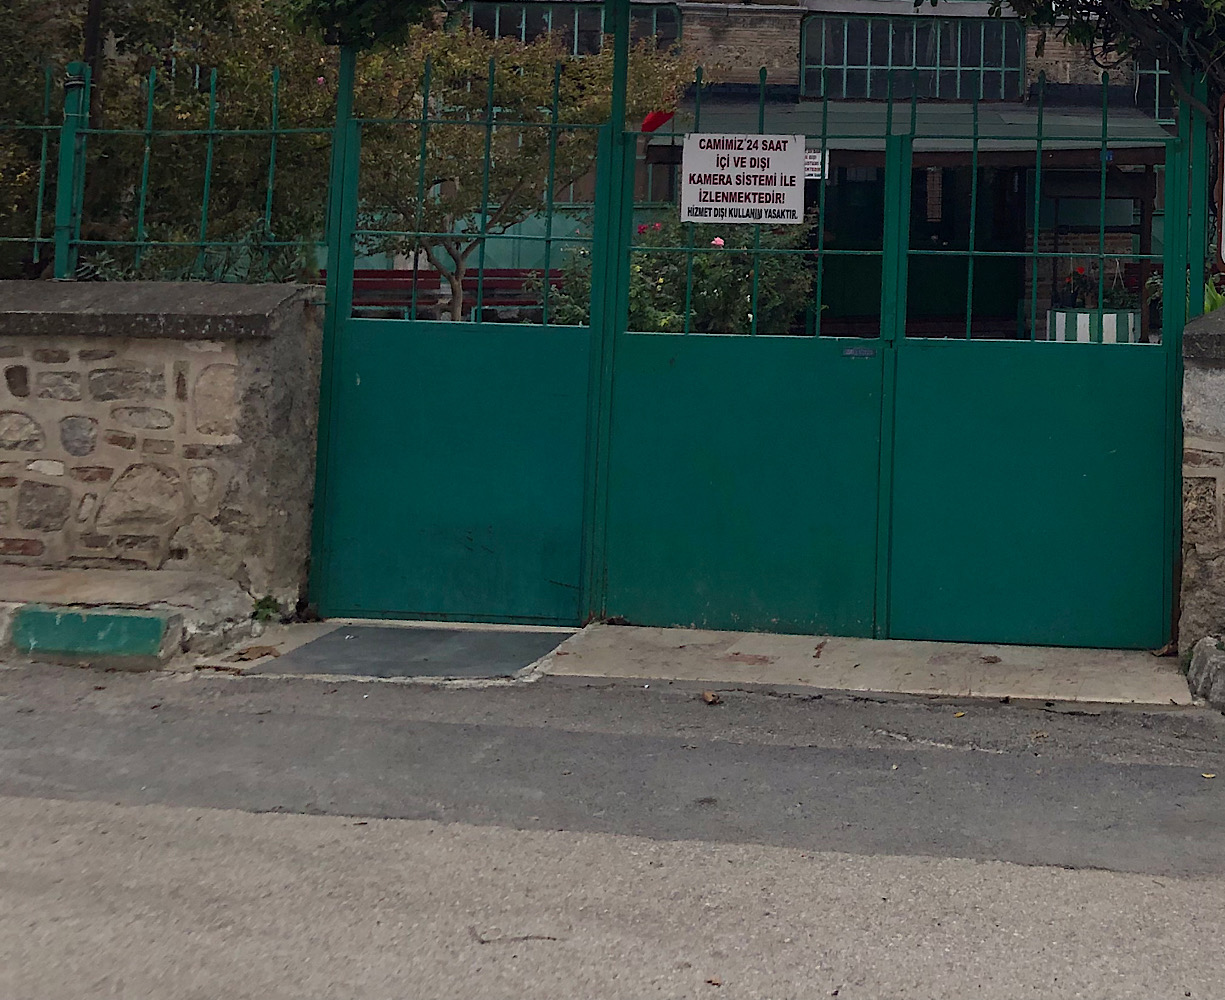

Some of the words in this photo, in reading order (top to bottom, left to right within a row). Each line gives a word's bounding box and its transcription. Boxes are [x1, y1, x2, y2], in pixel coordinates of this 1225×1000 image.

[746, 139, 759, 151] 24
[761, 139, 789, 152] SAAT
[716, 153, 730, 170] İÇİ
[733, 156, 747, 168] VE
[749, 157, 770, 171] DIŞI
[688, 172, 733, 186] KAMERA
[735, 171, 777, 187] SİSTEMİ
[780, 172, 797, 187] İLE
[698, 187, 786, 204] İZLENMEKTEDİR!
[687, 204, 713, 218] HİZMET
[713, 207, 728, 220] DIŞI
